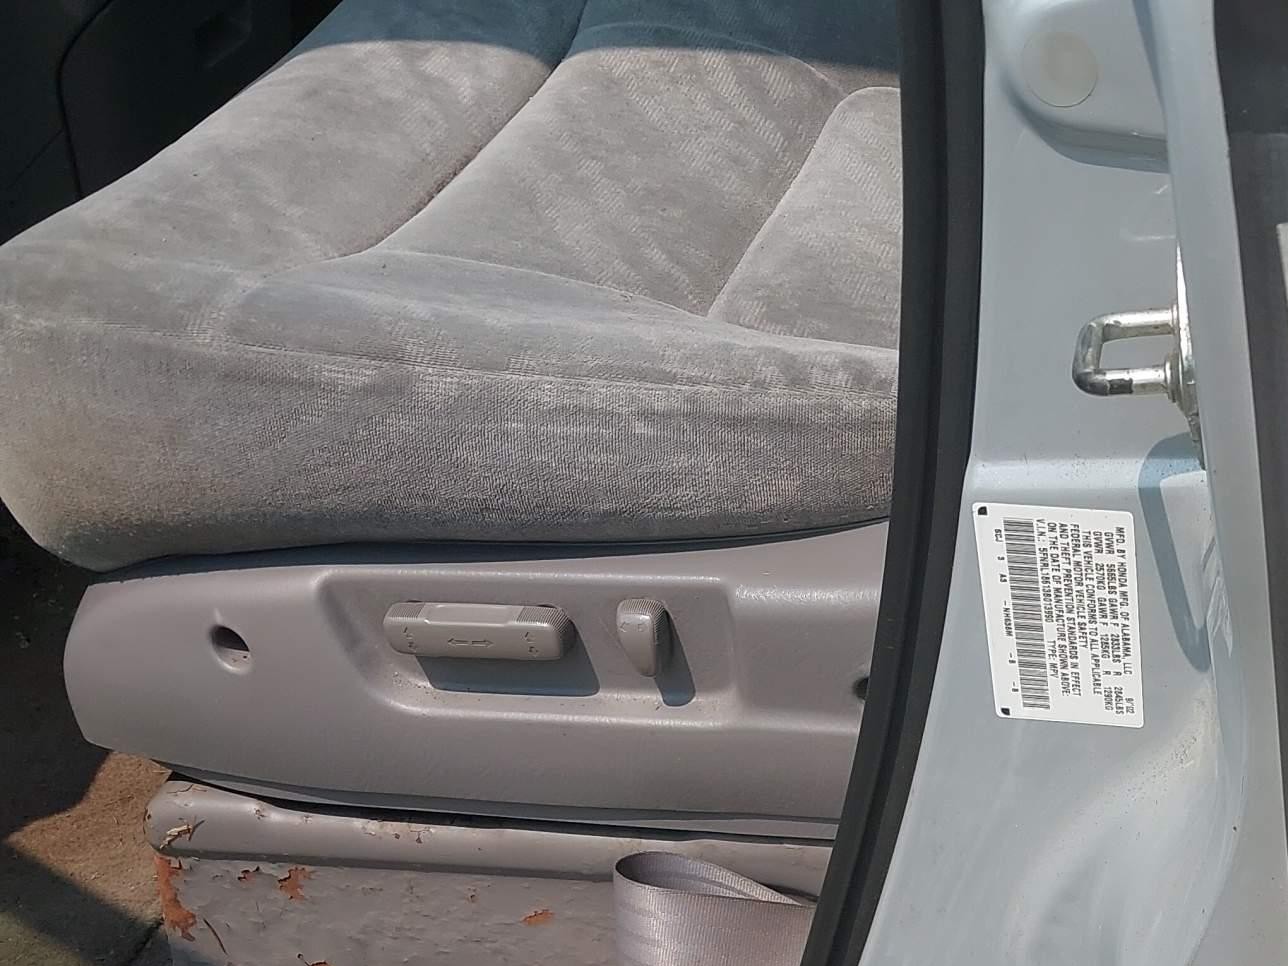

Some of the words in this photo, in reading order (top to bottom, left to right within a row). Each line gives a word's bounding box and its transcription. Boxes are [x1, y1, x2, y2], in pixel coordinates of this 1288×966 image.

[1048, 522, 1057, 532] ON
[1059, 523, 1069, 539] AND
[1049, 536, 1059, 550] THE
[1071, 524, 1081, 558] FEDERAL
[1082, 530, 1091, 548] THIS
[1093, 531, 1103, 554] GVWR
[1051, 553, 1060, 572] DATE
[1060, 542, 1071, 565] THEFT
[1117, 549, 1126, 559] BY
[1073, 561, 1083, 586] MOTOR
[1084, 551, 1094, 581] VEHICLE
[1095, 563, 1105, 590] 2570KG
[1104, 532, 1114, 554] GVWR
[1109, 598, 1118, 620] GAWR
[1118, 562, 1127, 587] HONDA
[1052, 575, 1062, 584] OF
[1063, 569, 1075, 614] PREVENTION
[1119, 591, 1128, 609] MFG.
[1053, 588, 1065, 641] MANUFACTURE
[1076, 590, 1086, 619] VEHICLE
[1086, 584, 1097, 624] CONFORMS
[1098, 597, 1107, 619] GAWR
[1120, 612, 1129, 621] OF
[1067, 617, 1079, 660] STANDARDS
[1078, 622, 1088, 648] SAFETY
[1089, 627, 1097, 636] TO
[1047, 640, 1057, 660] TYPE:
[1090, 638, 1099, 651] ALL
[1058, 644, 1068, 669] SHOWN
[1049, 663, 1058, 678] MPV
[1091, 654, 1101, 695] APPLICABLE
[1123, 663, 1132, 675] LLC
[1071, 672, 1081, 696] EFFECT
[1104, 687, 1113, 710] 1290KG
